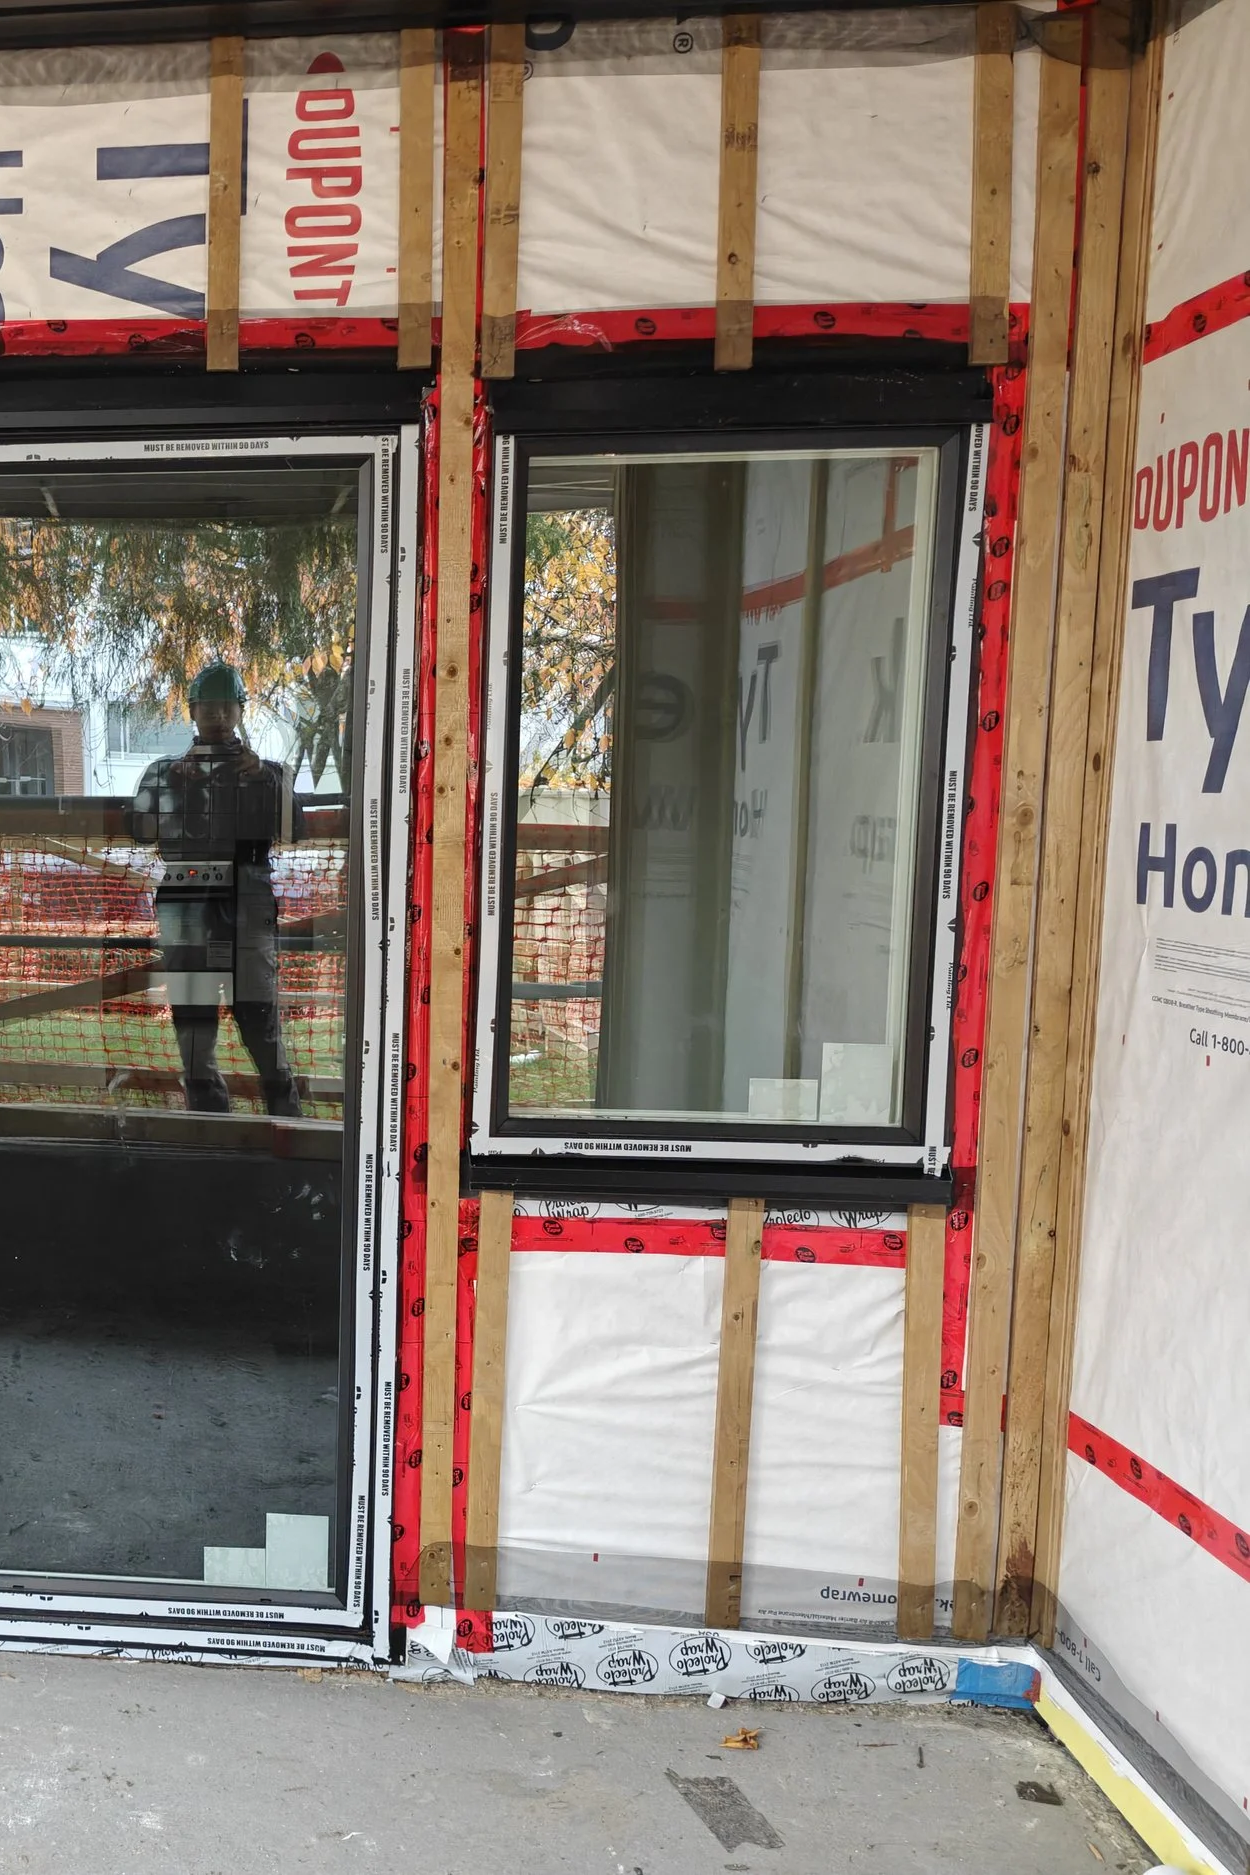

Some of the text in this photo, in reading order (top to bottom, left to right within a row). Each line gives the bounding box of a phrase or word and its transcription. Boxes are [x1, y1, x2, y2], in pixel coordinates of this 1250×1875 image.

[284, 87, 363, 307] DUPONT
[143, 440, 269, 452] MUST BE REMOVED WITHIN 90 DAYS
[381, 448, 390, 458] BE
[501, 446, 510, 474] WITHIN
[971, 449, 982, 479] WITHIN
[381, 458, 390, 494] REMOVED
[970, 479, 979, 491] 90
[500, 475, 509, 511] REMOVED
[968, 491, 978, 512] DAYS
[381, 494, 389, 522] WITHIN
[499, 512, 508, 522] BE
[380, 522, 389, 534] 90
[498, 523, 508, 544] MUST
[380, 534, 389, 554] DAYS
[1131, 567, 1250, 793] Ty
[942, 770, 958, 899] MUST BE REMOVED WITHIN 90 DAYS
[487, 792, 498, 916] MUST BE REMOVED WITHIN 90 DAYS
[1189, 1027, 1208, 1047] Call
[389, 1032, 400, 1152] MUST BE REMOVED WITHIN 90 DAYS
[564, 1141, 692, 1152] MUST BE REMOVED WITHIN 90 DAYS
[927, 1145, 937, 1166] MUST
[362, 1153, 373, 1271] MUST BE REMOVED WITHIN 90 DAYS
[381, 1381, 392, 1496] MUST BE REMOVED WITHIN 90 DAYS
[352, 1494, 366, 1608] MUST BE REMOVED WITHIN 90 DAYS
[167, 1607, 285, 1619] MUST BE REMOVED WITHIN 90 DAYS
[207, 1637, 326, 1653] MUST BE REMOVED WITHIN 90 DAYS
[680, 1637, 719, 1660] Wrap
[534, 1662, 573, 1680] Wrap
[607, 1649, 645, 1670] Wrap
[676, 1647, 730, 1678] Protecto
[898, 1657, 937, 1679] Wrap
[1085, 1656, 1101, 1682] Call
[603, 1657, 657, 1687] Protecto
[824, 1673, 863, 1690] Wrap
[893, 1669, 948, 1695] Protecto
[817, 1680, 871, 1704] Protecto
